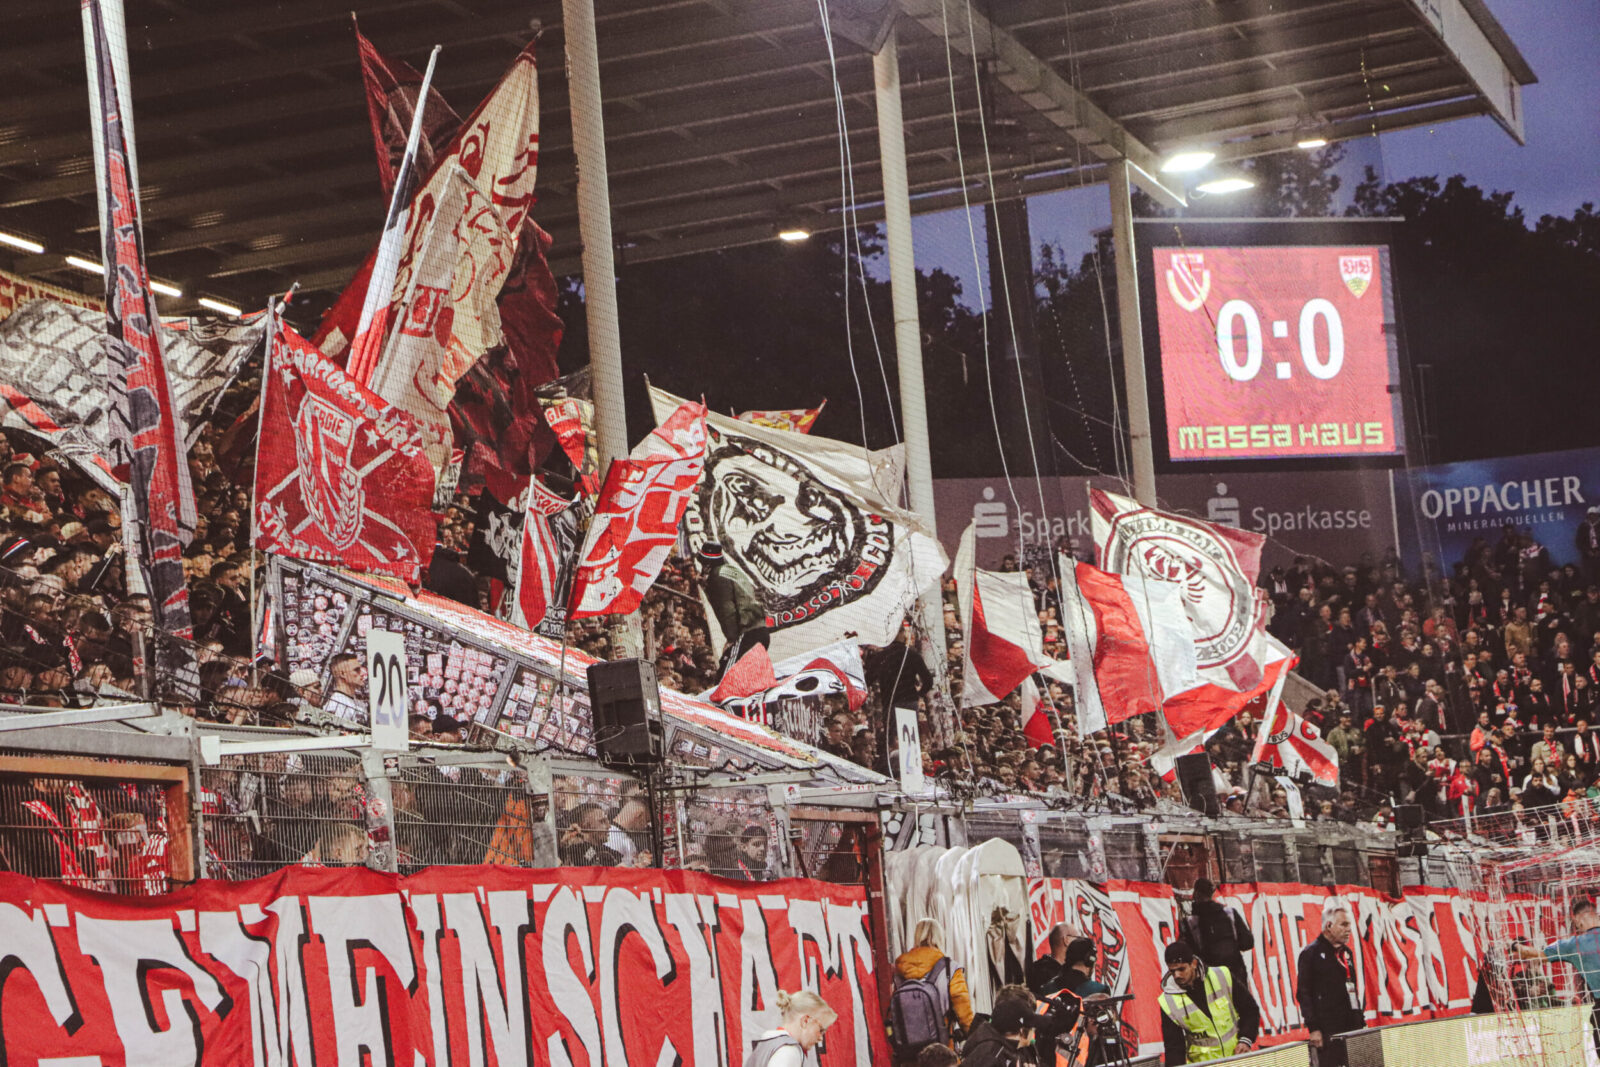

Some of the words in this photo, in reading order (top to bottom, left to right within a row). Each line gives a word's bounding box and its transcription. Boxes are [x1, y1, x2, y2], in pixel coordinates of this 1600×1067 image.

[1216, 298, 1345, 381] 0:0
[1251, 504, 1372, 536] Sparkasse
[1420, 475, 1585, 520] OPPACHER
[1021, 507, 1090, 540] Spark
[372, 652, 405, 727] 20
